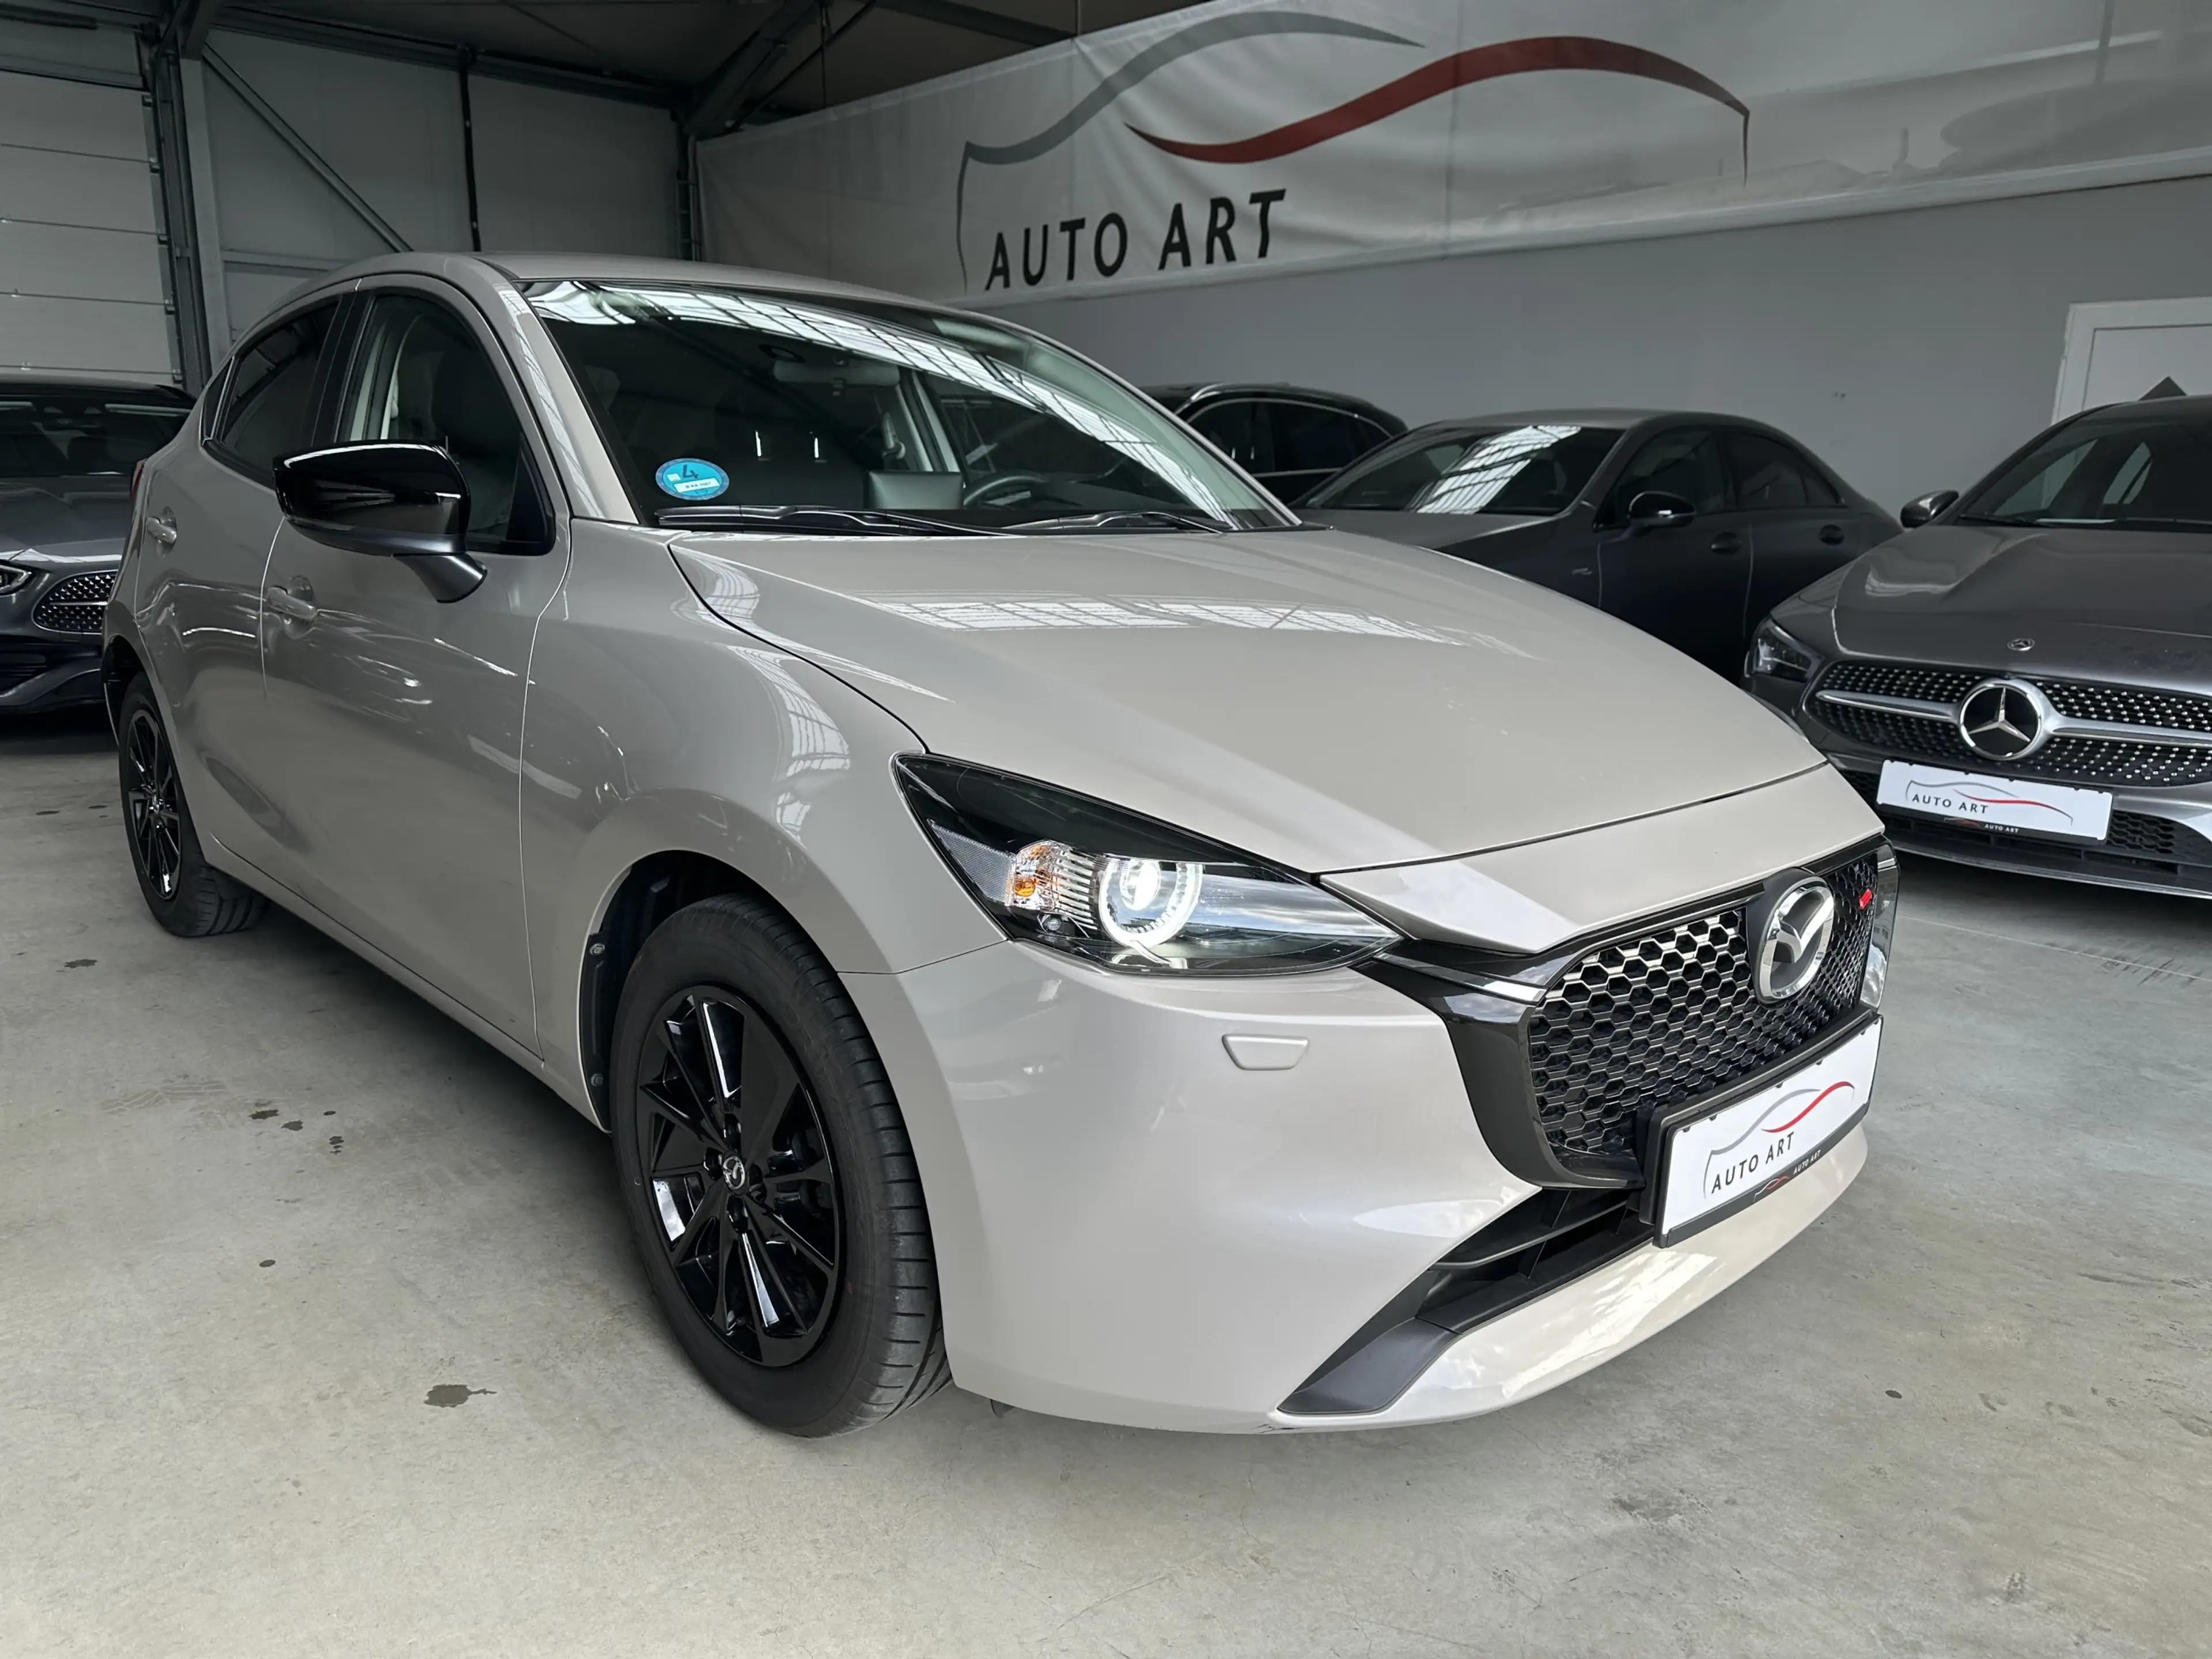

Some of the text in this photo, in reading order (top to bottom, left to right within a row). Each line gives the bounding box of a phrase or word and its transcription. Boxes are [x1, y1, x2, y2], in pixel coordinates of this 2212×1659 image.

[985, 188, 1286, 290] AUTO ART
[681, 464, 699, 479] 4
[1912, 793, 1988, 814] AUTO ART
[1711, 1131, 1794, 1194] AUTO ART
[1793, 1150, 1821, 1175] AUTO ART
